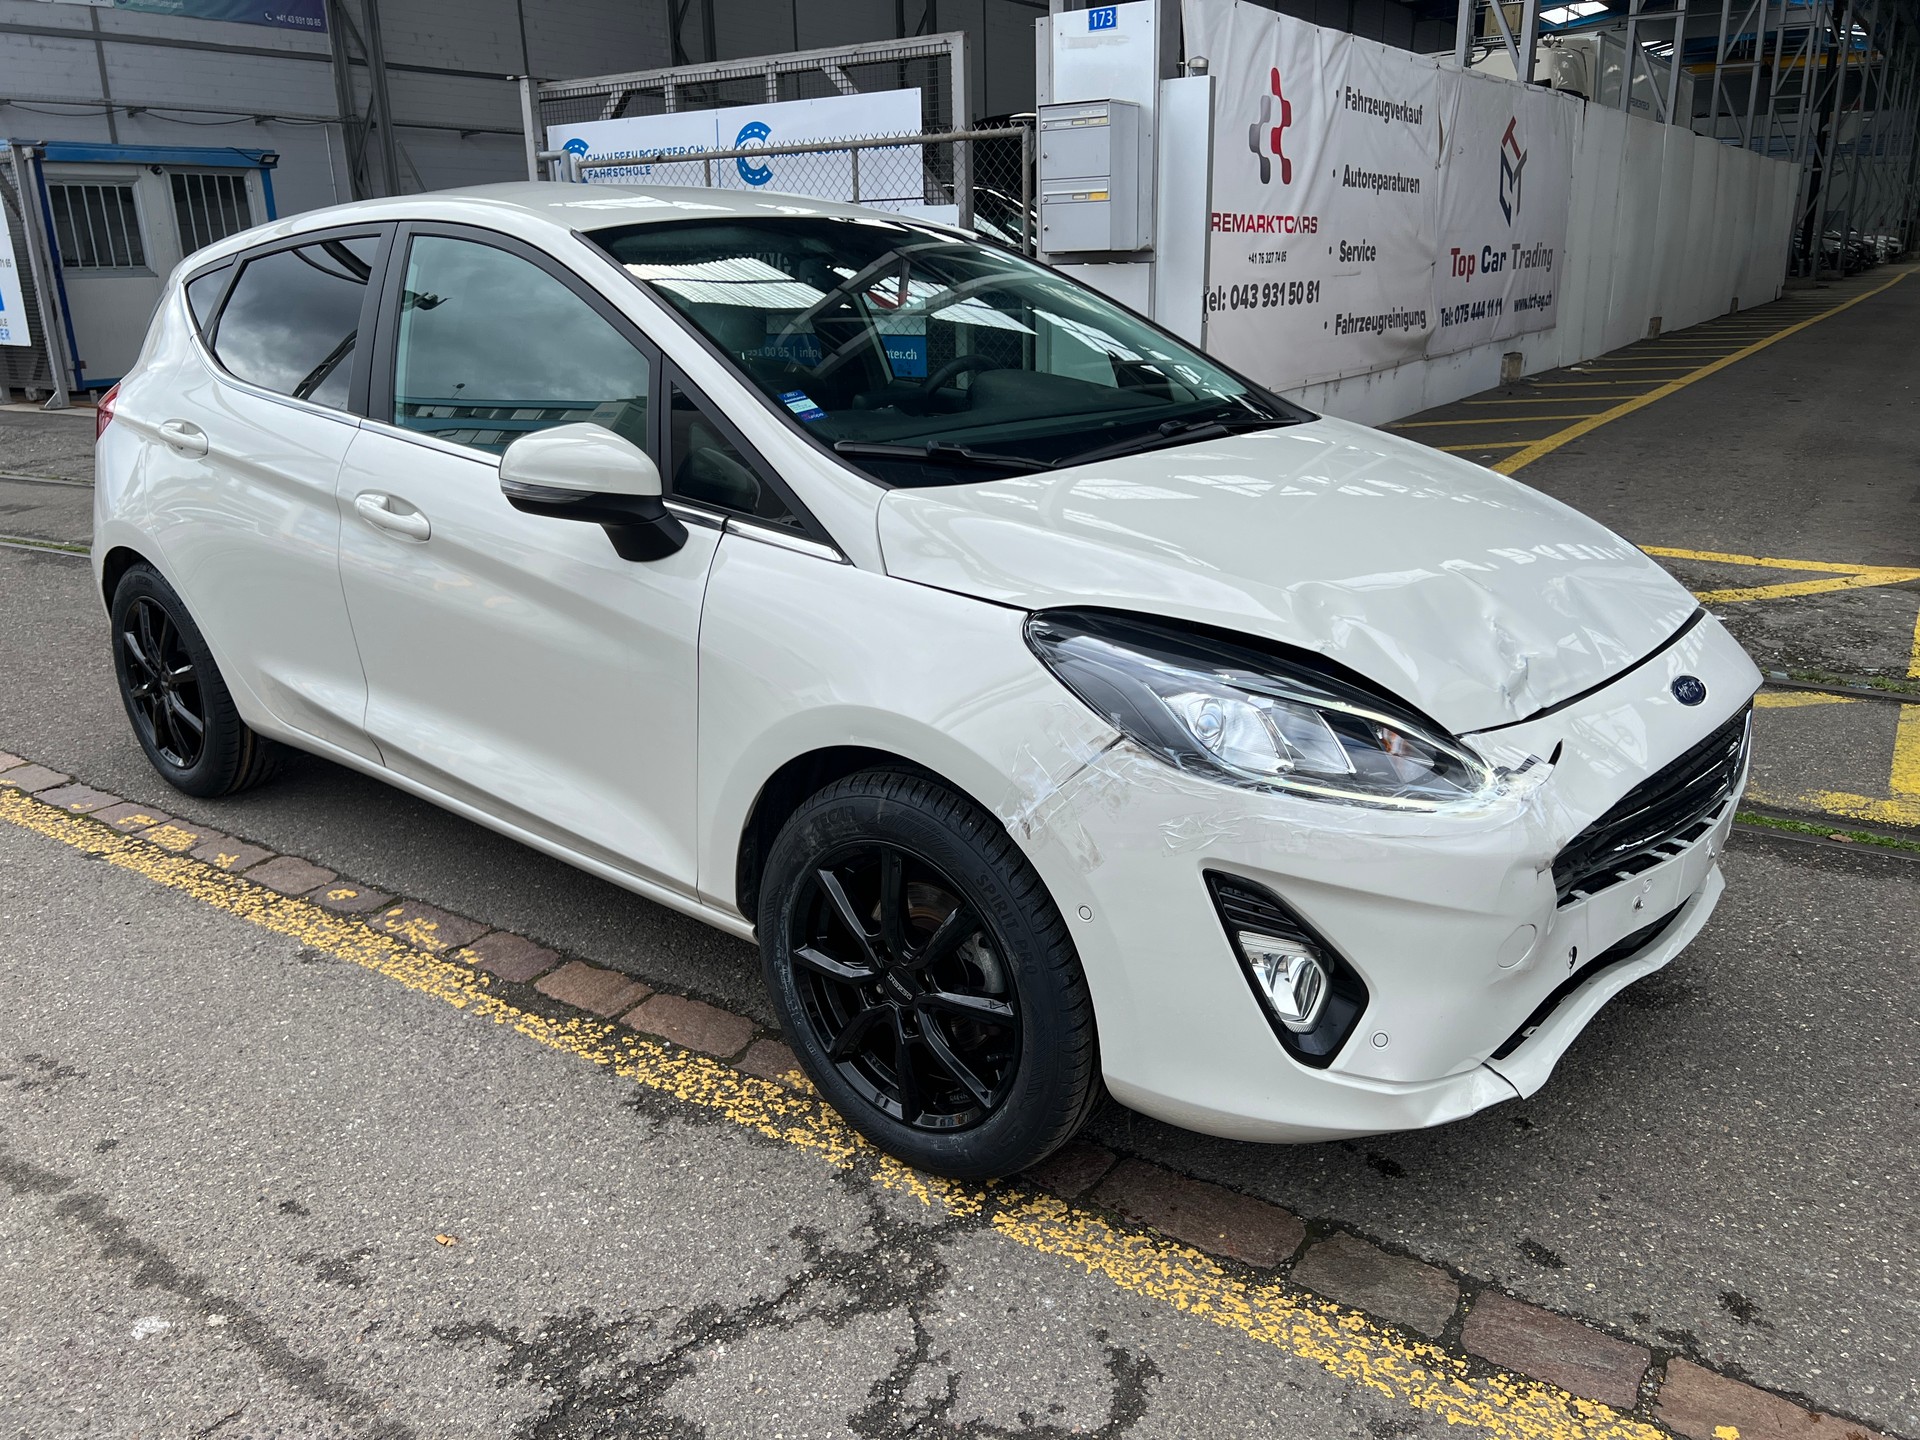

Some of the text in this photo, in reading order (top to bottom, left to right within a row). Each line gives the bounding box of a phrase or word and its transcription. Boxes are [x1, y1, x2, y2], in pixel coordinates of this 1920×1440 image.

[1092, 10, 1113, 27] 173
[1345, 85, 1423, 125] Fahrzeugverkauf
[588, 165, 651, 179] FAHRSCHULE
[1342, 164, 1420, 195] Autoreparaturen
[1211, 212, 1318, 234] REMARKTCARS
[1248, 252, 1258, 264] +41
[1258, 252, 1265, 264] 76
[1265, 251, 1275, 263] 327
[1275, 251, 1281, 263] 74
[1339, 238, 1376, 263] Service
[1450, 242, 1553, 283] Top Car Trading
[1206, 280, 1320, 312] el: 043 931 50 81
[1334, 306, 1427, 336] Fahrzeugreinigung
[1441, 298, 1503, 328] Tel: 075 444 11 11
[764, 346, 776, 357] 00
[777, 346, 790, 358] 85
[976, 873, 1039, 975] SPIRIT PRO
